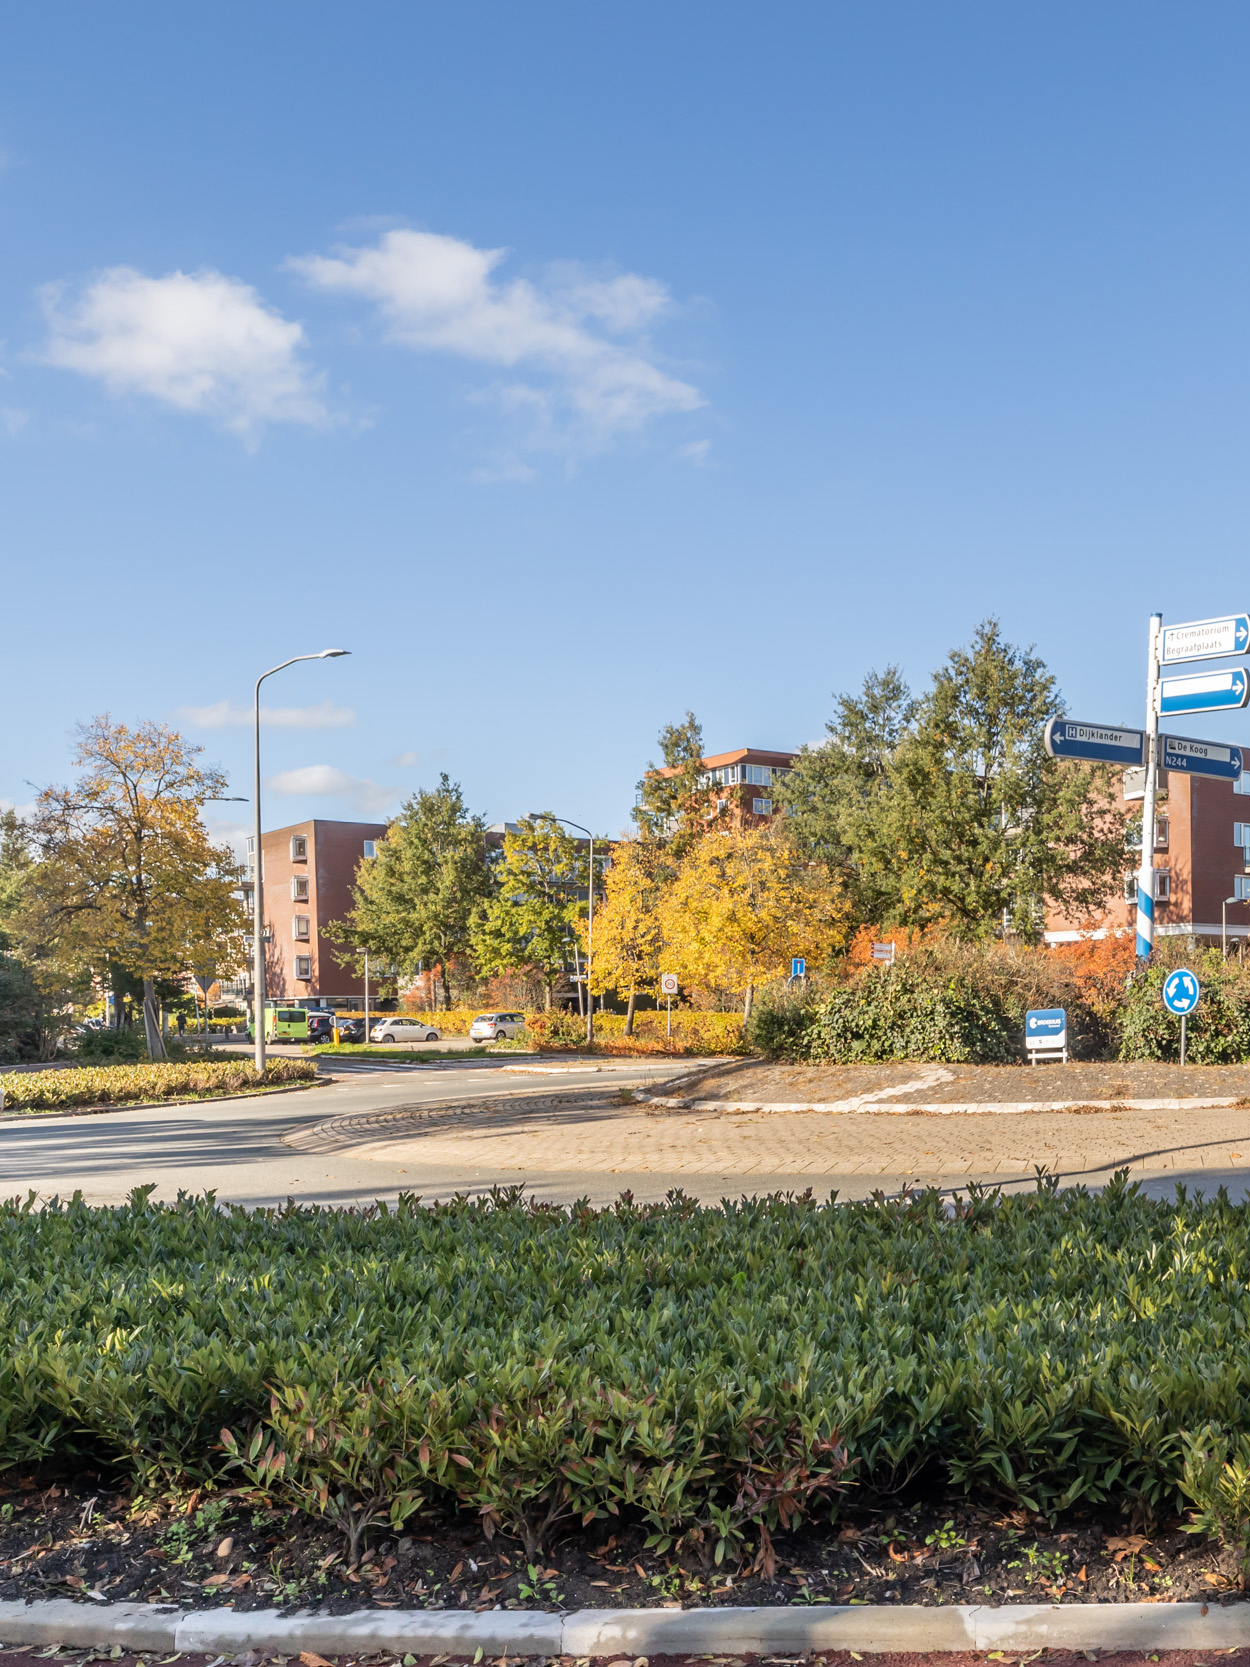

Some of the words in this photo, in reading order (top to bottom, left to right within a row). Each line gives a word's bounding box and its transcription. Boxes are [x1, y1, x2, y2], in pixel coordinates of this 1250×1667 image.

[1176, 625, 1229, 640] Crematorium
[1166, 641, 1222, 656] Begraafplaats
[1079, 728, 1122, 742] Dijklander
[1177, 742, 1188, 752] De
[1189, 744, 1208, 757] Koog
[1165, 755, 1187, 767] N244
